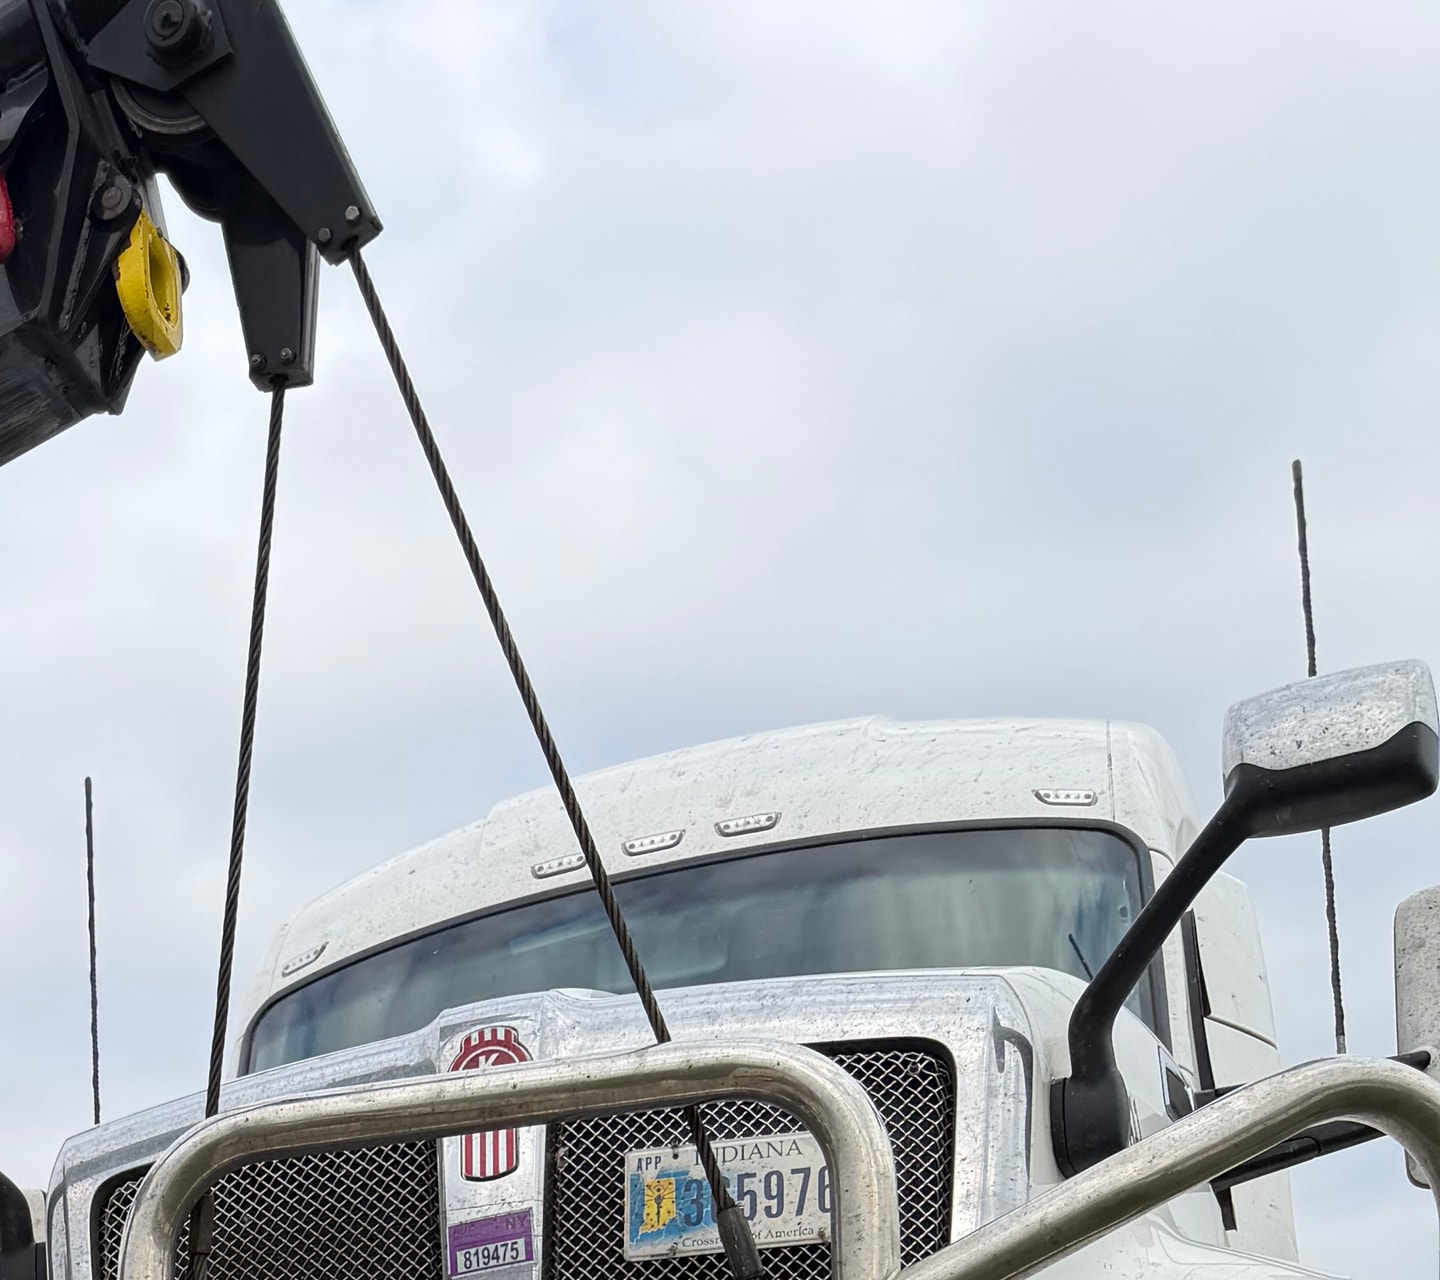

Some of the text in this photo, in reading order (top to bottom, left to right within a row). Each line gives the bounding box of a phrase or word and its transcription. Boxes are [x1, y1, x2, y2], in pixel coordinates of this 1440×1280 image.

[636, 1156, 662, 1172] APP
[506, 1214, 528, 1230] NY
[764, 1225, 815, 1240] America
[463, 1240, 520, 1270] 819475
